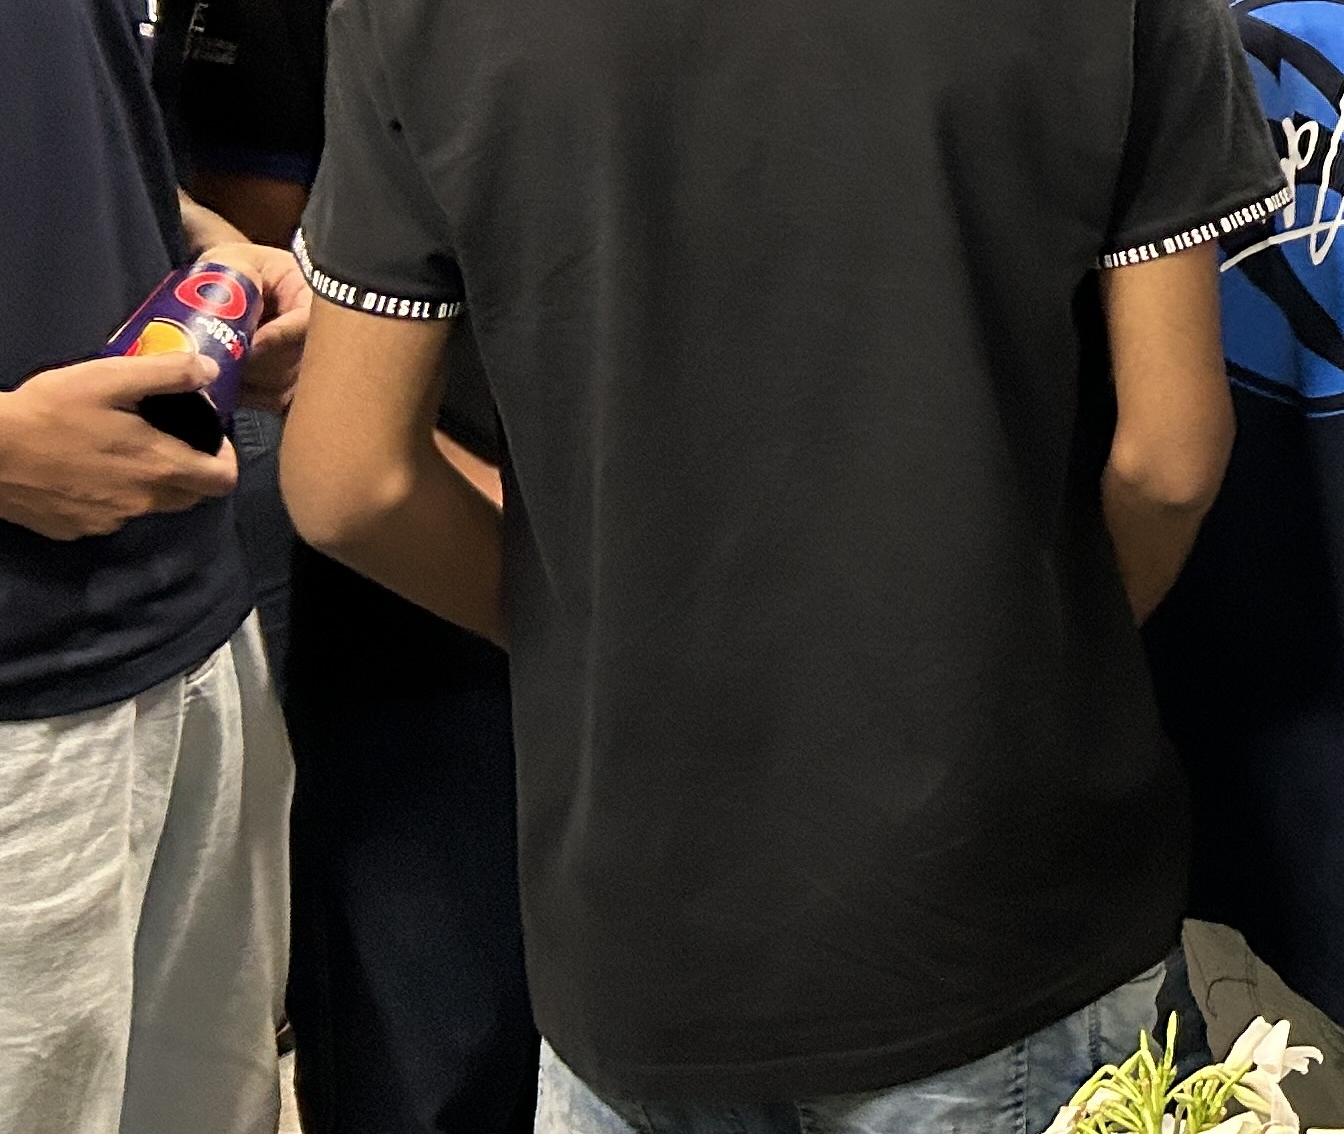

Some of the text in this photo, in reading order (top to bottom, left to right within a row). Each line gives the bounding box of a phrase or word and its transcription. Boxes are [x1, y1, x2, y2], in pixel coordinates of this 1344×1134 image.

[1162, 222, 1219, 255] DIESEL
[1219, 202, 1266, 233] DIESEL
[362, 292, 431, 319] DIESEL
